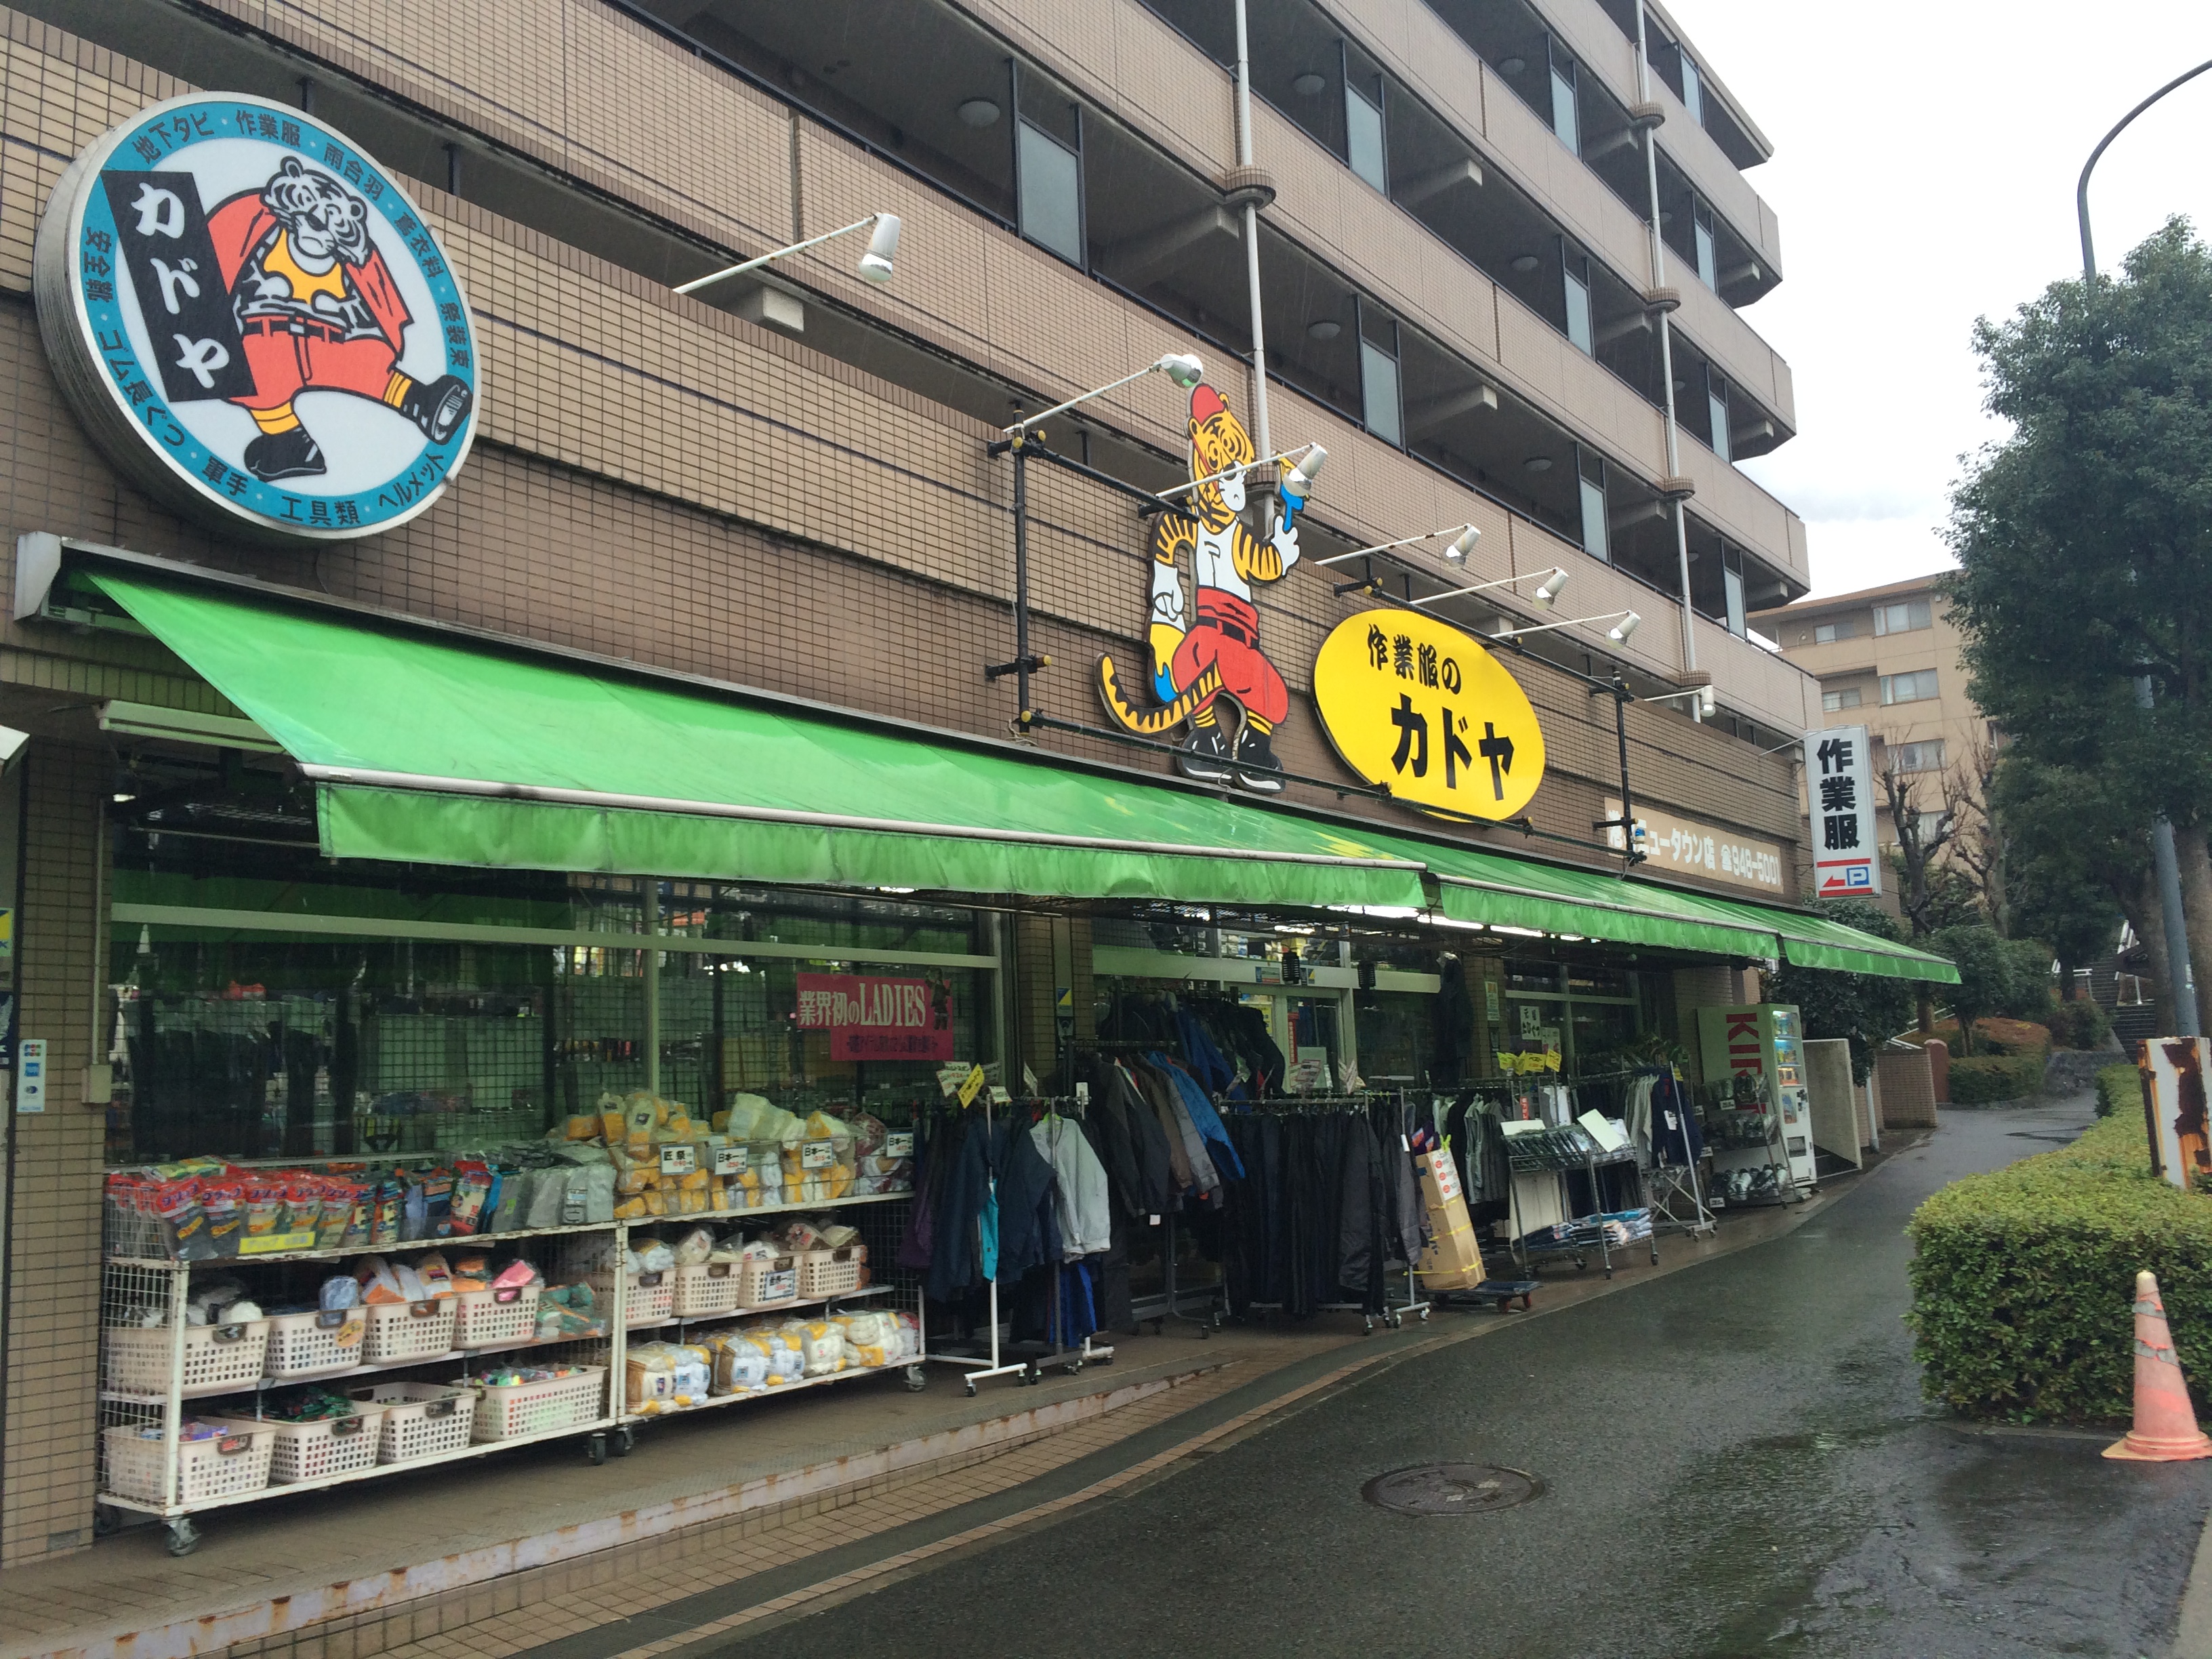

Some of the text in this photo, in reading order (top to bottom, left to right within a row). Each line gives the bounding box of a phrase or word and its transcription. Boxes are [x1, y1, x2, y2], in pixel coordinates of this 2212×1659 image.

[131, 110, 215, 165] 地下タビ
[235, 109, 301, 148] 作業服
[324, 142, 385, 201] 雨合羽
[83, 226, 445, 527] 安全靴 ゴム長ぐつ 軍手 工具類 ヘルメット
[1367, 623, 1461, 695] 作業服の
[1391, 692, 1515, 801] カドヤ
[1817, 738, 1860, 851] 作業服
